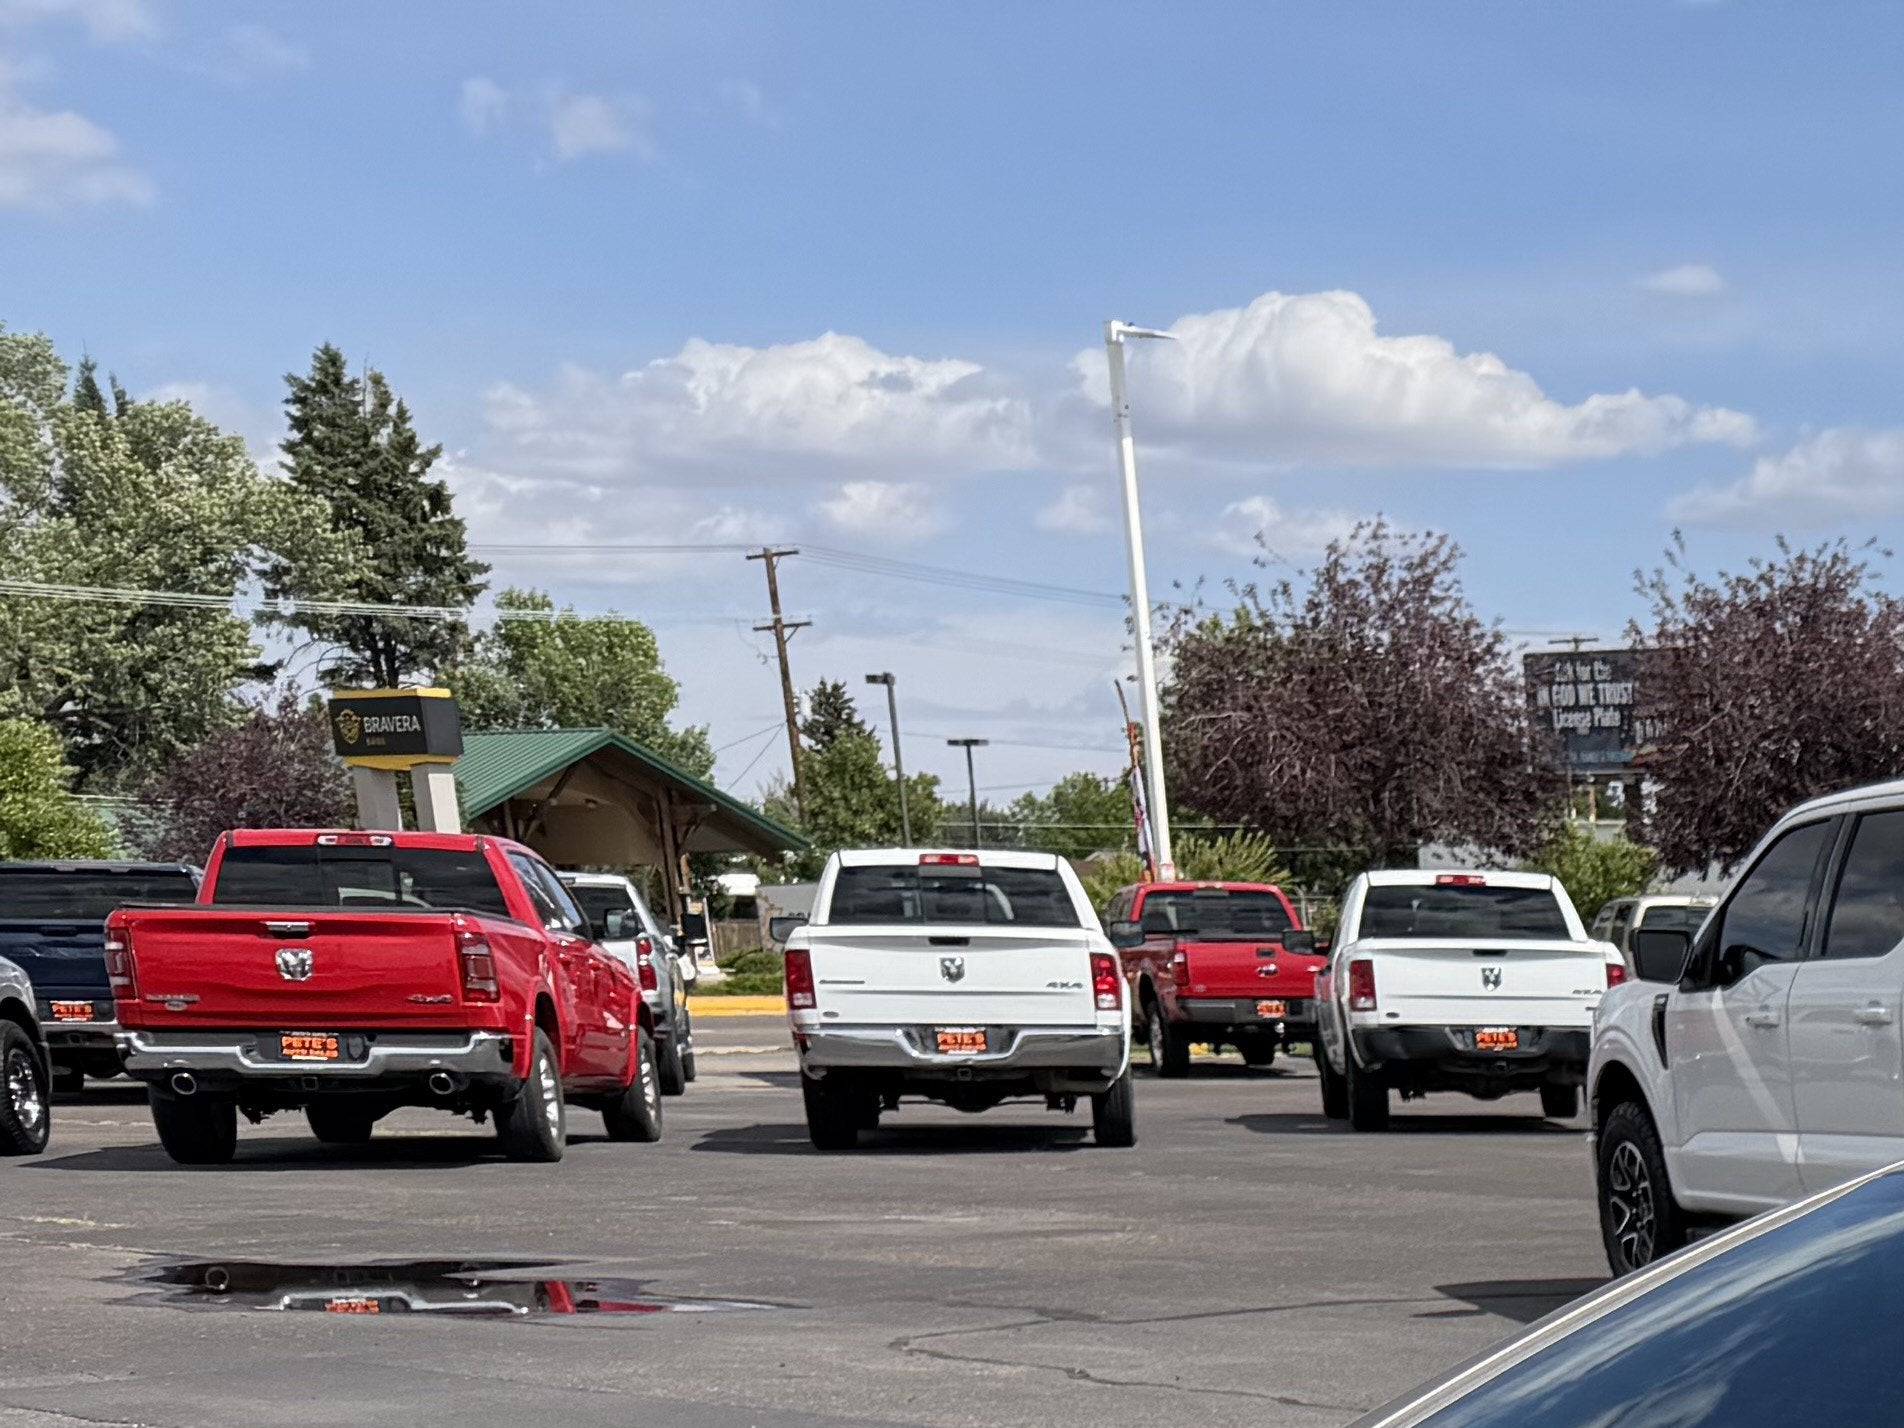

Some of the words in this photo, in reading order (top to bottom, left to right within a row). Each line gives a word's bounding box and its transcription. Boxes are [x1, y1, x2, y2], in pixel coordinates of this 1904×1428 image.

[1551, 684, 1576, 706] GOD
[1577, 683, 1595, 706] WE
[363, 715, 421, 733] BRAVERA
